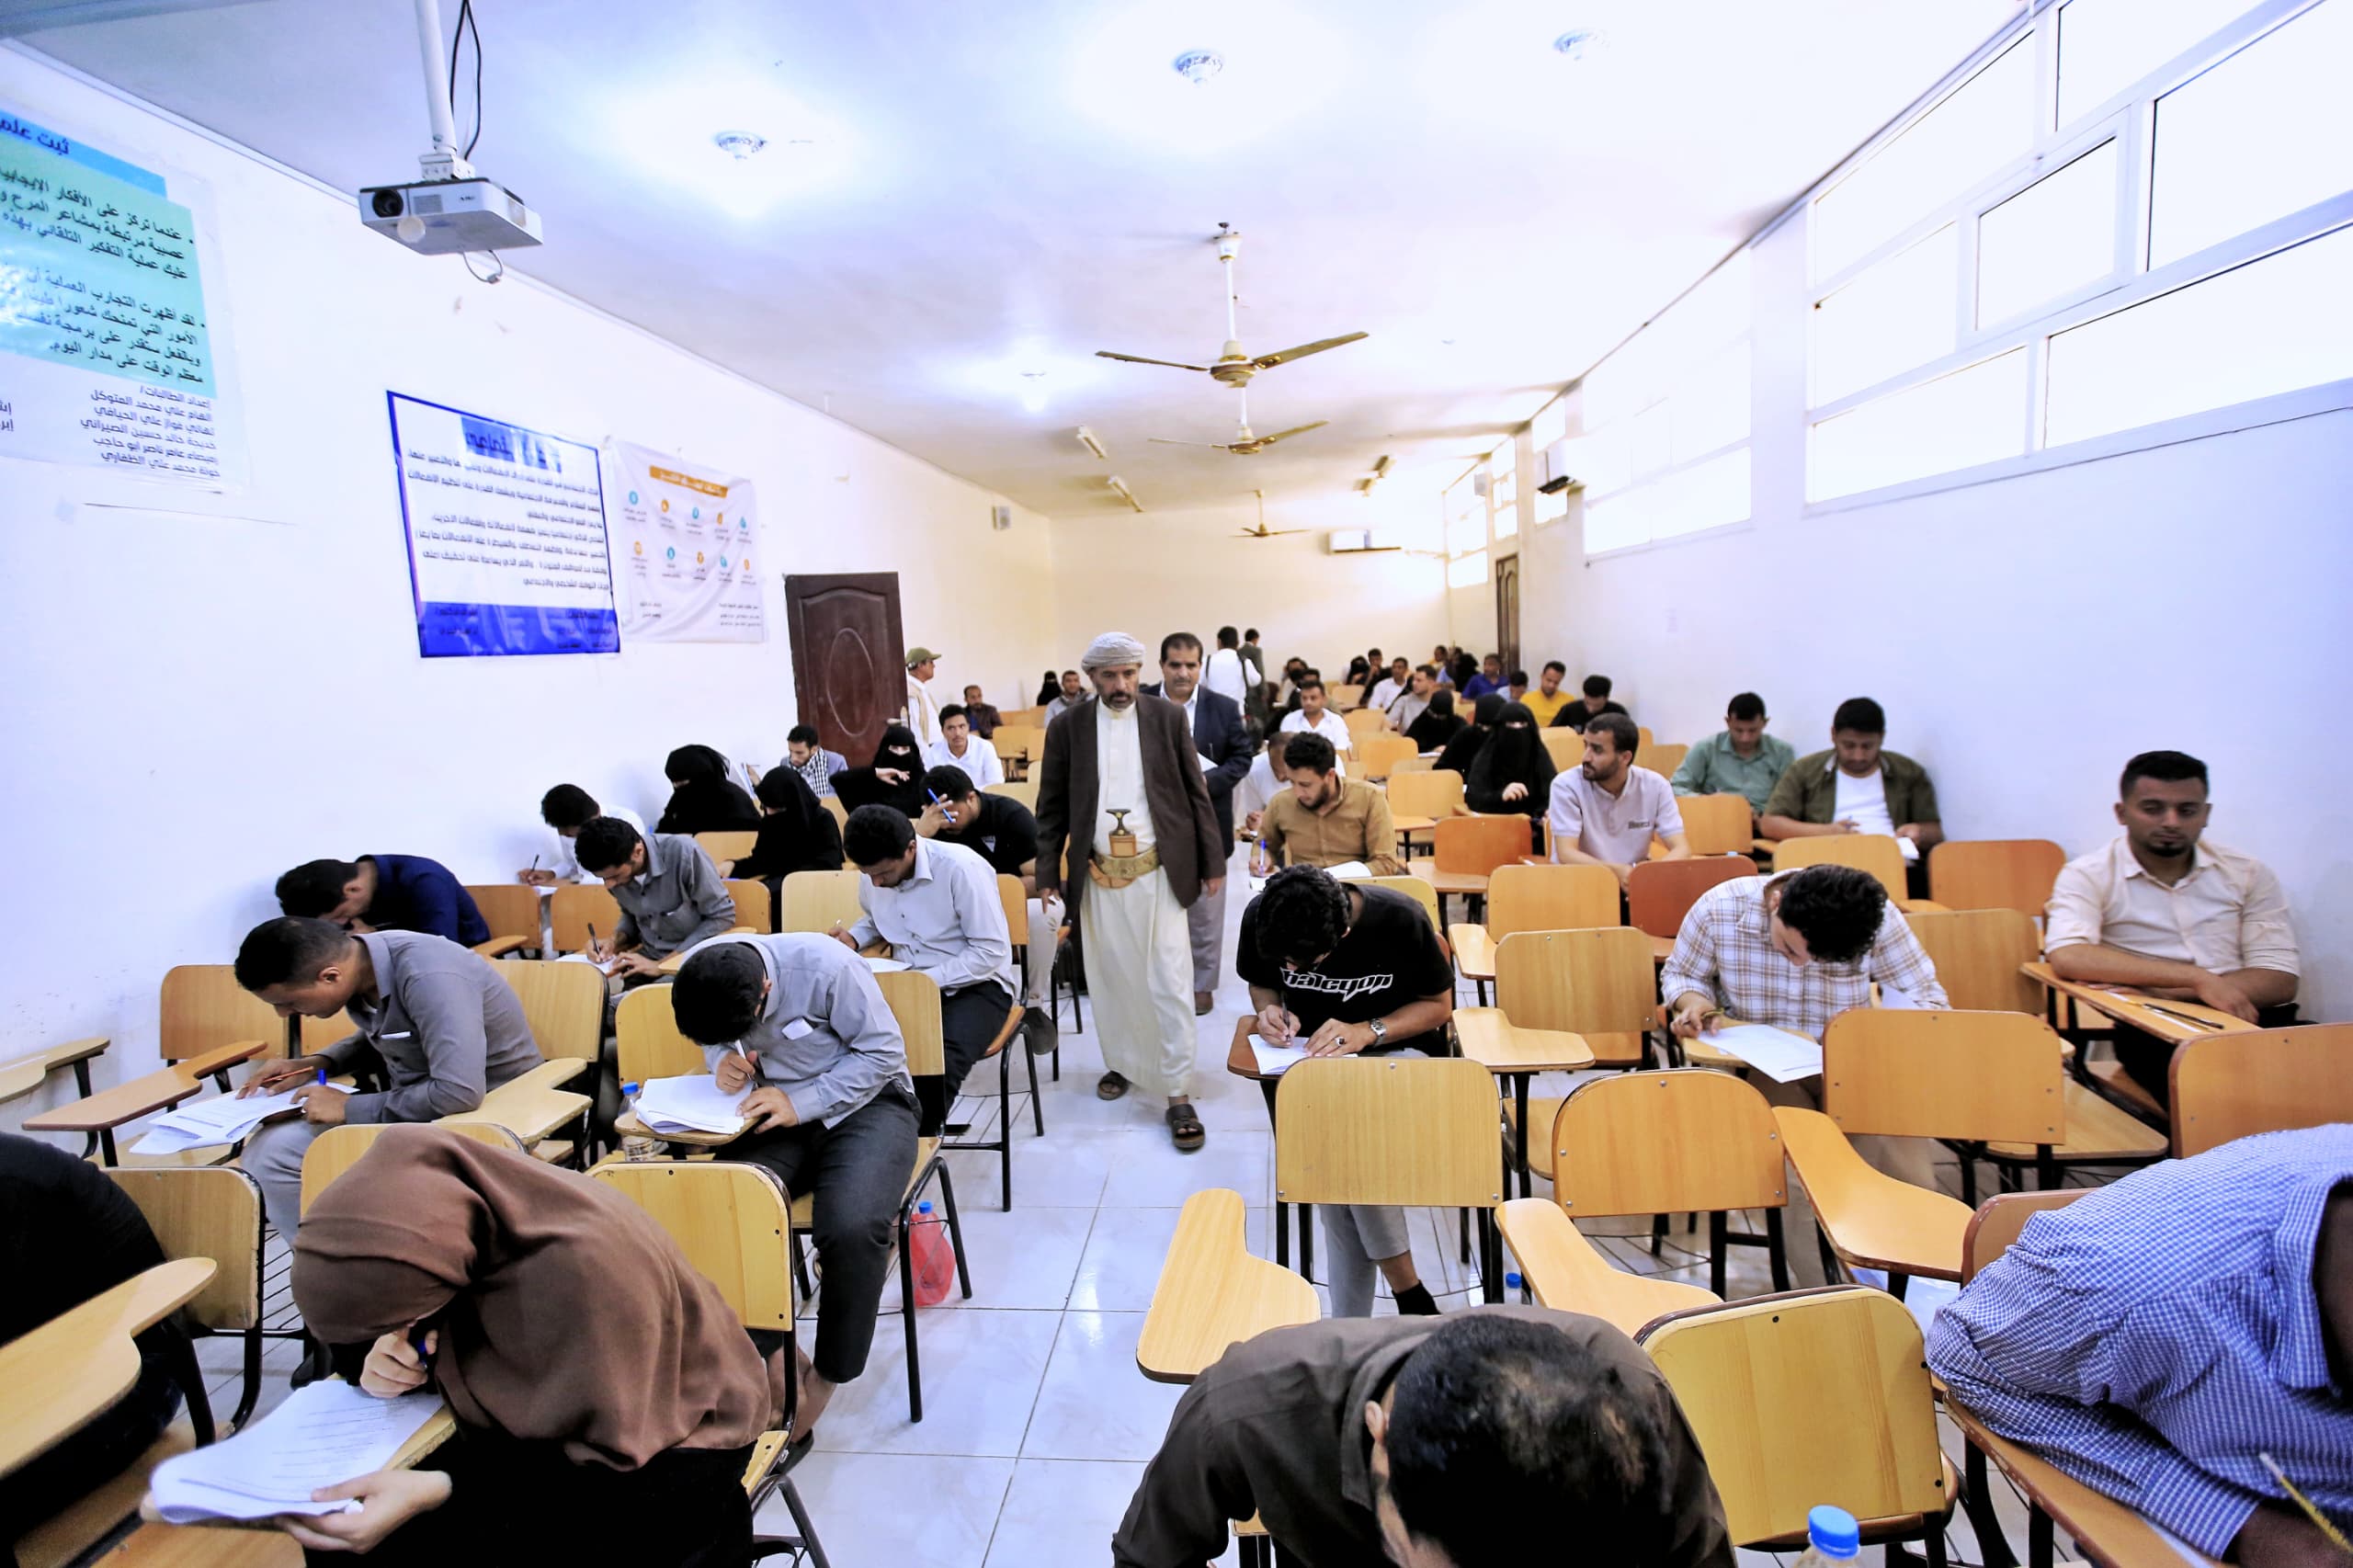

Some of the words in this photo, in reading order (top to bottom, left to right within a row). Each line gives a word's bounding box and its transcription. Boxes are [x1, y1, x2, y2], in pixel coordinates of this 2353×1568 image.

[38, 133, 70, 155] ثبت
[97, 201, 119, 217] على
[3, 209, 32, 231] بهذه
[57, 210, 101, 233] بمشاعر
[126, 212, 151, 231] تركز
[104, 220, 145, 247] مرتبطة
[153, 222, 182, 239] عندما
[89, 242, 123, 257] التفكير
[149, 236, 184, 259] عصبية
[128, 247, 159, 269] عملية
[91, 290, 136, 308] التجارب
[99, 330, 122, 345] على
[141, 324, 162, 338] التي
[117, 354, 139, 369] على
[143, 359, 173, 378] الوقت
[1279, 967, 1393, 1002] halcyon
